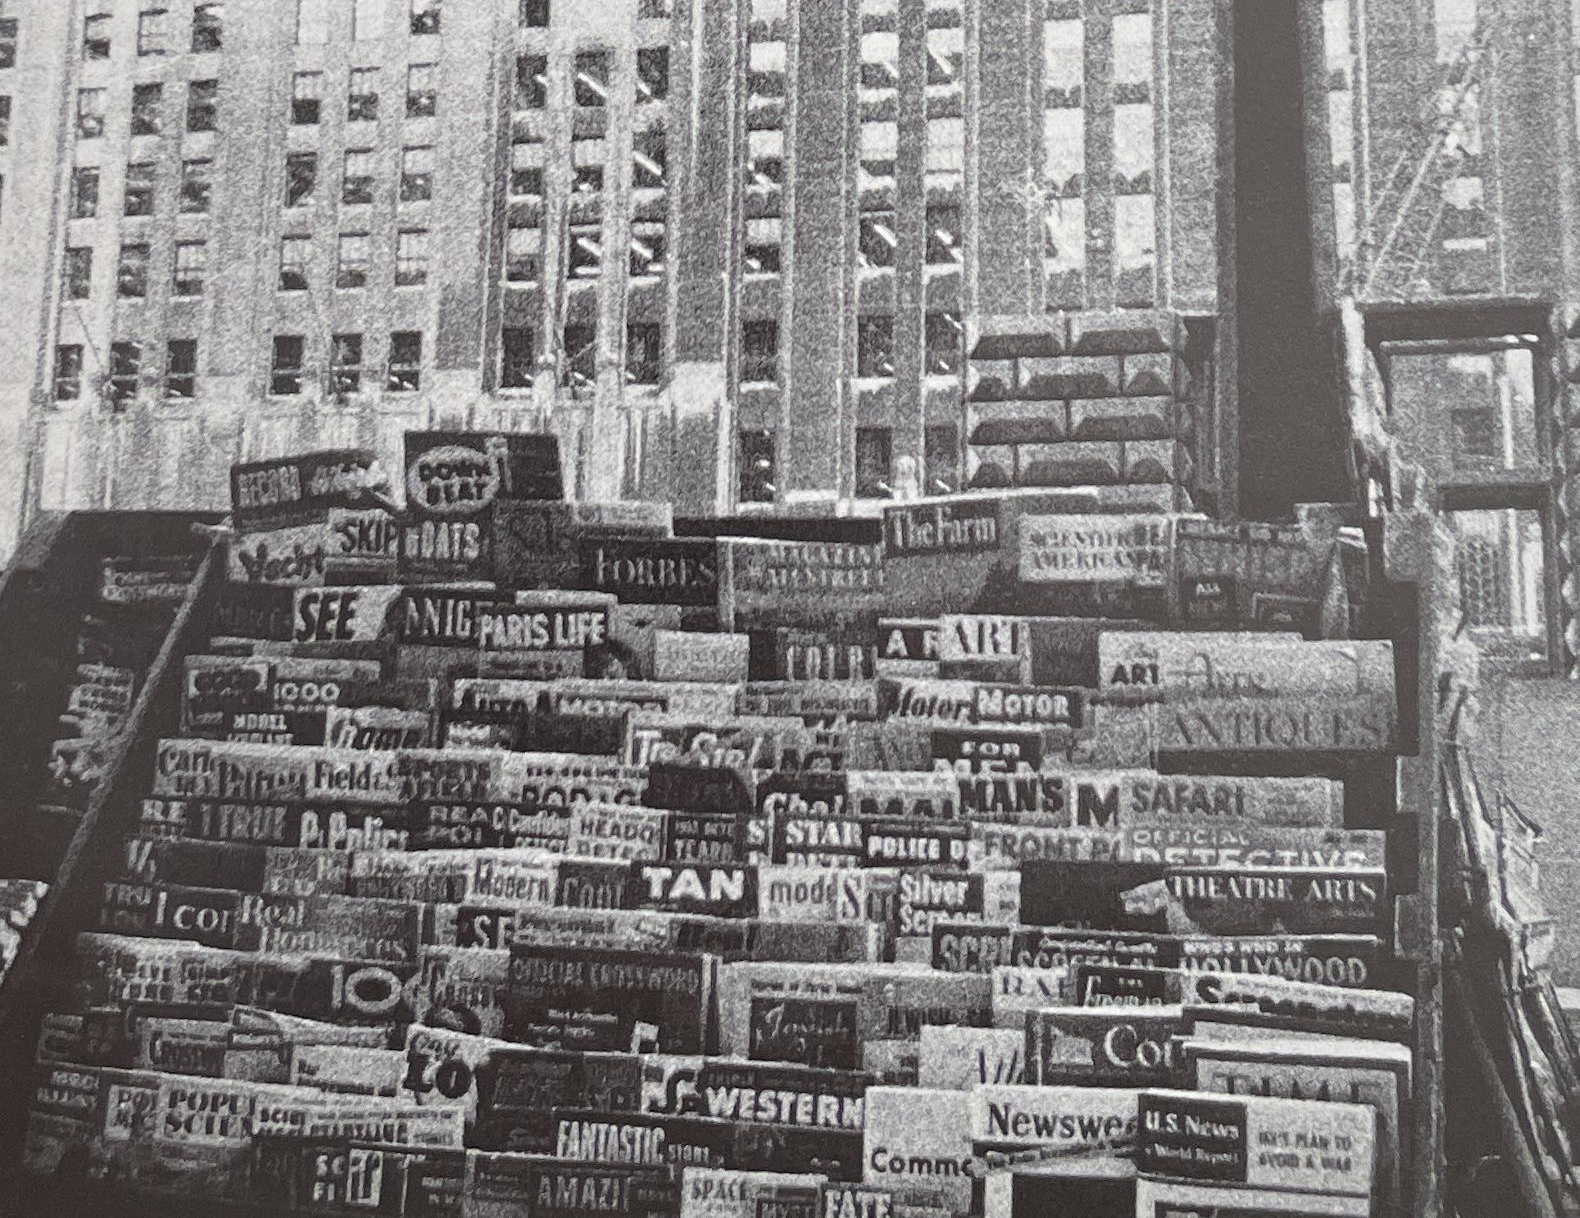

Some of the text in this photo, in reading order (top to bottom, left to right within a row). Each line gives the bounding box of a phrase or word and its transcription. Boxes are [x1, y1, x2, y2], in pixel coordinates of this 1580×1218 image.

[419, 461, 490, 483] DOWN
[596, 546, 718, 587] FORBES
[295, 593, 361, 642] SEE
[478, 610, 605, 649] PARIS LIFE
[1111, 663, 1159, 684] ART
[272, 682, 341, 702] 1000
[976, 689, 1070, 717] MOTOR
[1171, 711, 1391, 748] ANTIQUES
[315, 758, 374, 790] Field
[958, 778, 1065, 813] MAN'S
[1131, 782, 1244, 816] SAFARI
[218, 803, 288, 840] TRUE
[785, 819, 863, 848] STAR
[1132, 829, 1249, 846] OFFICIAL
[867, 835, 941, 861] POLICE
[1131, 844, 1368, 868] DETECTIVE
[641, 866, 745, 902] TAN
[900, 872, 970, 908] Silver
[1170, 875, 1379, 902] THEATRE ARTS
[240, 894, 303, 929] Real
[1177, 954, 1368, 984] HOLLYWOOD
[704, 1085, 864, 1128] WESTERN
[1144, 1109, 1240, 1139] U.S. News
[556, 1119, 666, 1165] FANTASTIC
[825, 1188, 892, 1218] FATE
